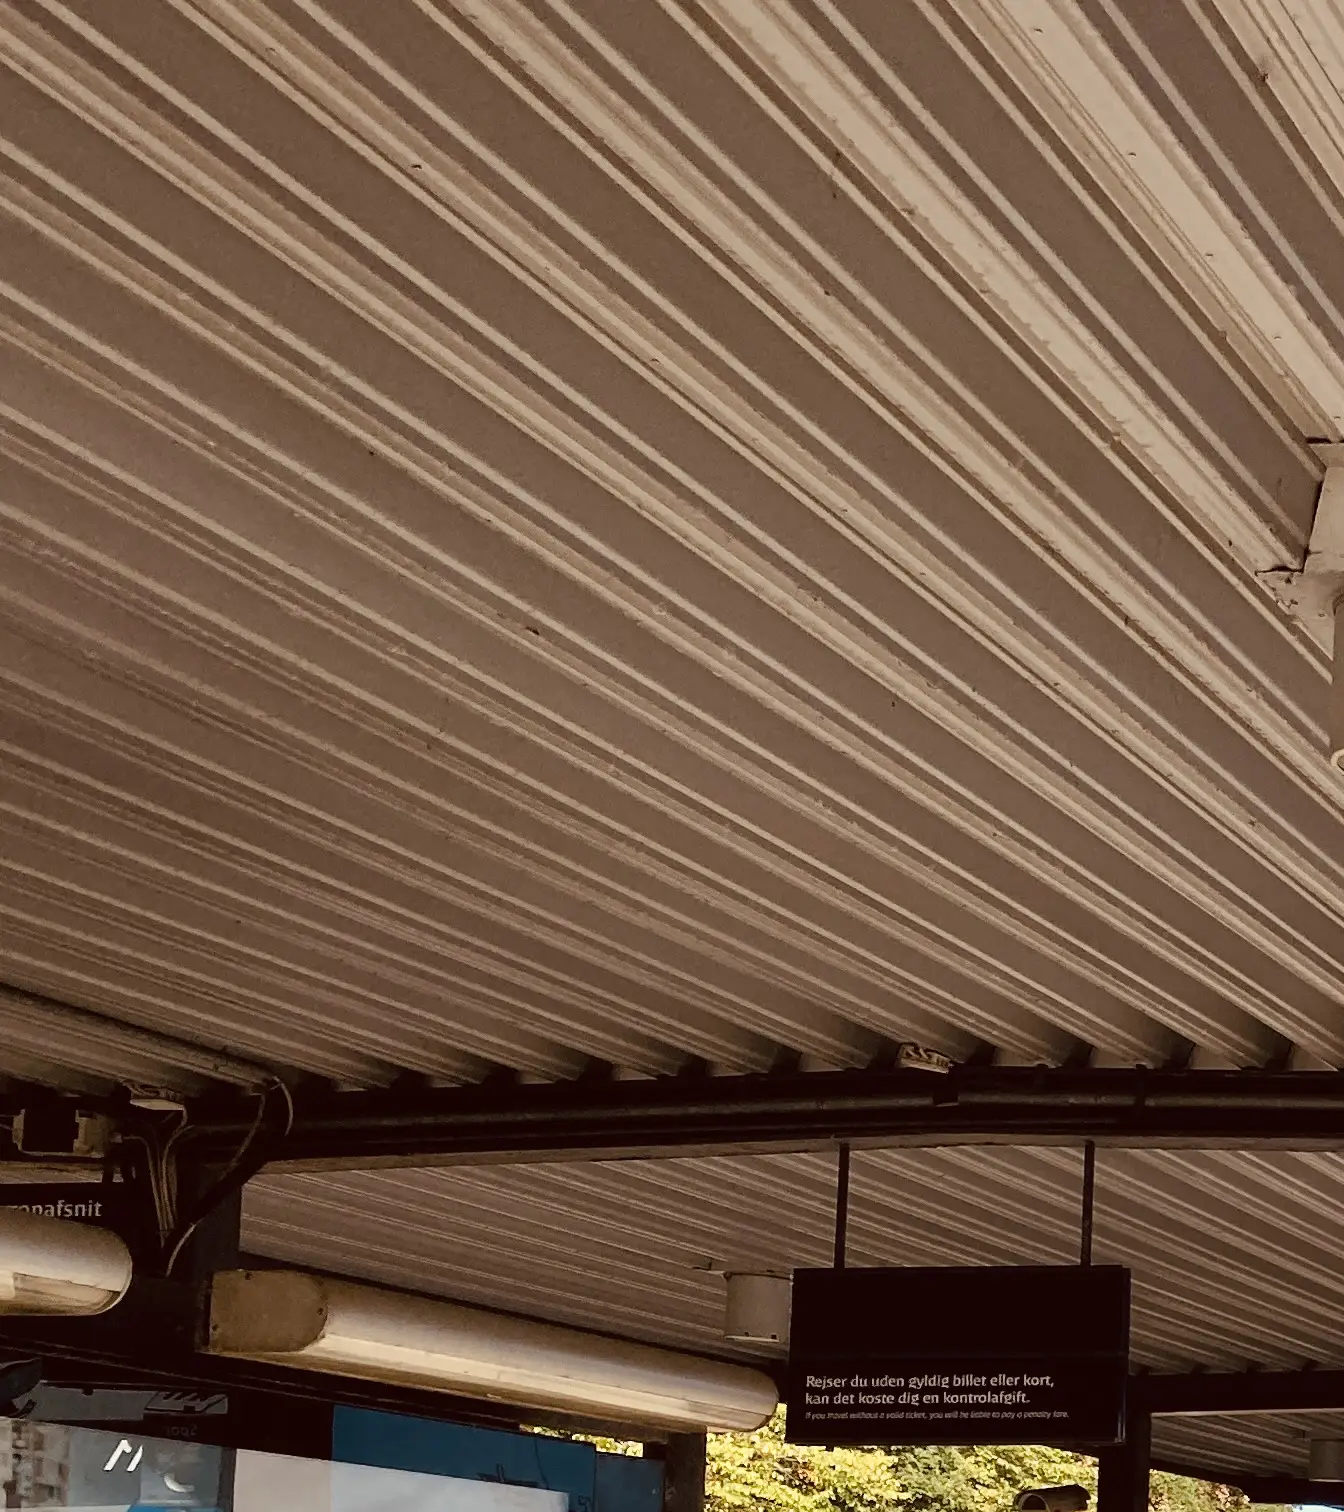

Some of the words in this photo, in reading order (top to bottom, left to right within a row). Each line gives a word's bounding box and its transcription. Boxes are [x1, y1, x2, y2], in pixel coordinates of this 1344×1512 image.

[806, 1375, 847, 1390] Rejser
[850, 1374, 868, 1387] du
[871, 1374, 905, 1387] uden
[908, 1374, 949, 1389] gyldig
[953, 1374, 987, 1387] billet
[989, 1374, 1020, 1387] eller
[1023, 1374, 1055, 1388] kort,
[805, 1392, 830, 1404] kan
[833, 1392, 855, 1404] det
[858, 1392, 895, 1404] koste
[898, 1392, 920, 1406] dig
[922, 1394, 939, 1404] en
[943, 1391, 1031, 1405] kontrolafgift.
